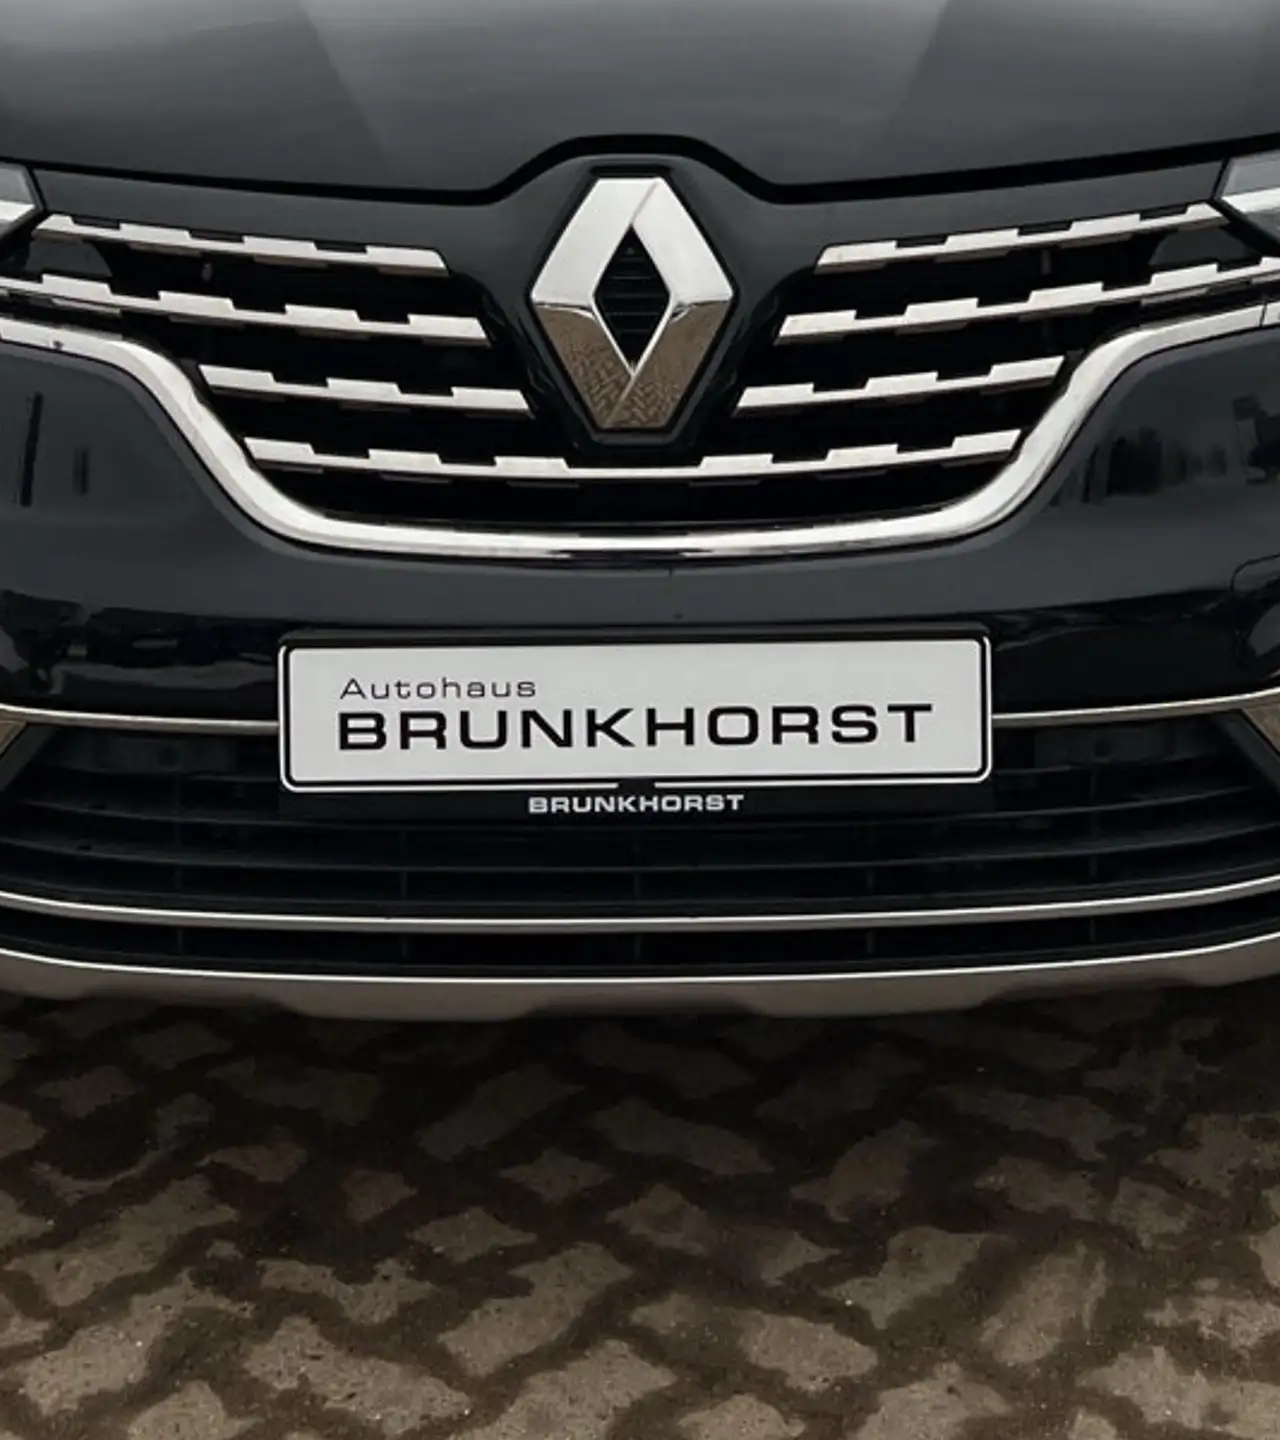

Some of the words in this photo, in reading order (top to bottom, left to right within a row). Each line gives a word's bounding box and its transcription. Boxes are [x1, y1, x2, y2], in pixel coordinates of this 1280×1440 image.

[339, 677, 538, 701] Autohaus
[338, 702, 934, 751] BRUNKHORST
[528, 793, 746, 814] BRUNKHORST
